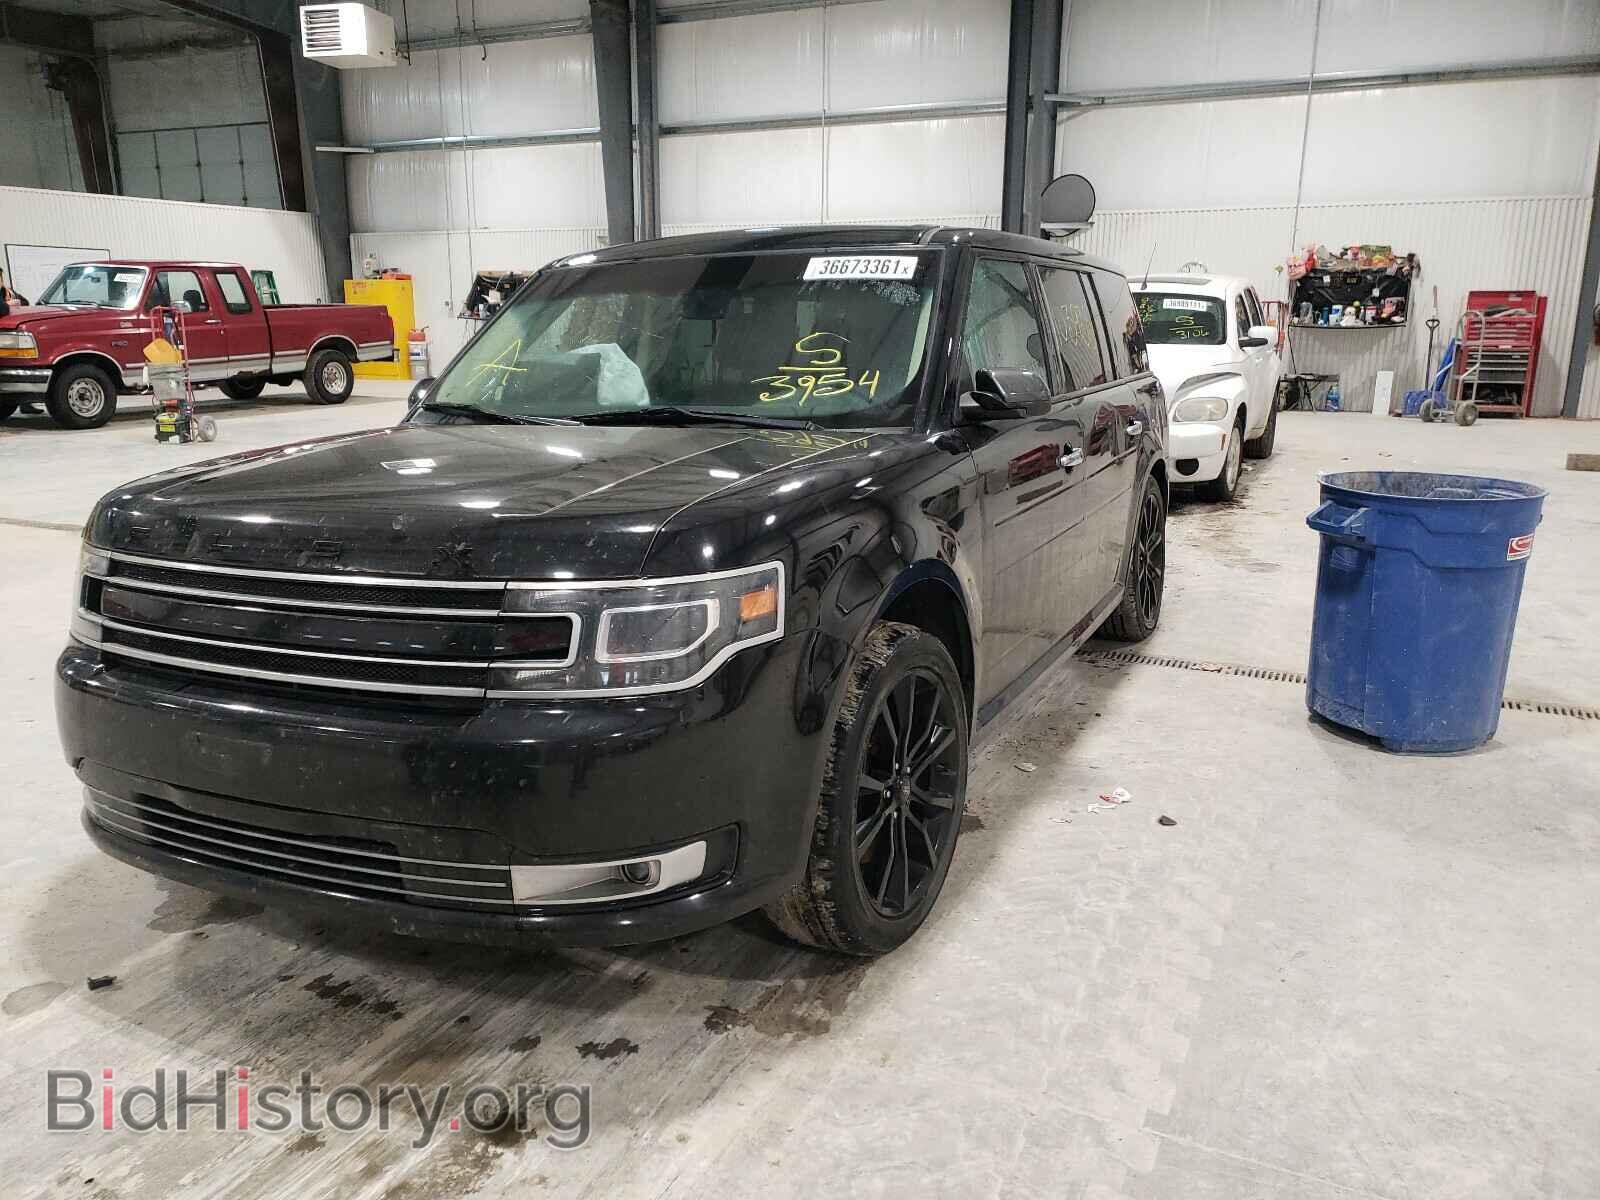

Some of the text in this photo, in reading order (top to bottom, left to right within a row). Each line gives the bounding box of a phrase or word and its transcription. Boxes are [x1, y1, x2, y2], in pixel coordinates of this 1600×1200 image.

[818, 259, 901, 275] 36673361
[465, 338, 528, 387] A
[795, 332, 851, 365] S
[751, 369, 881, 407] 3954
